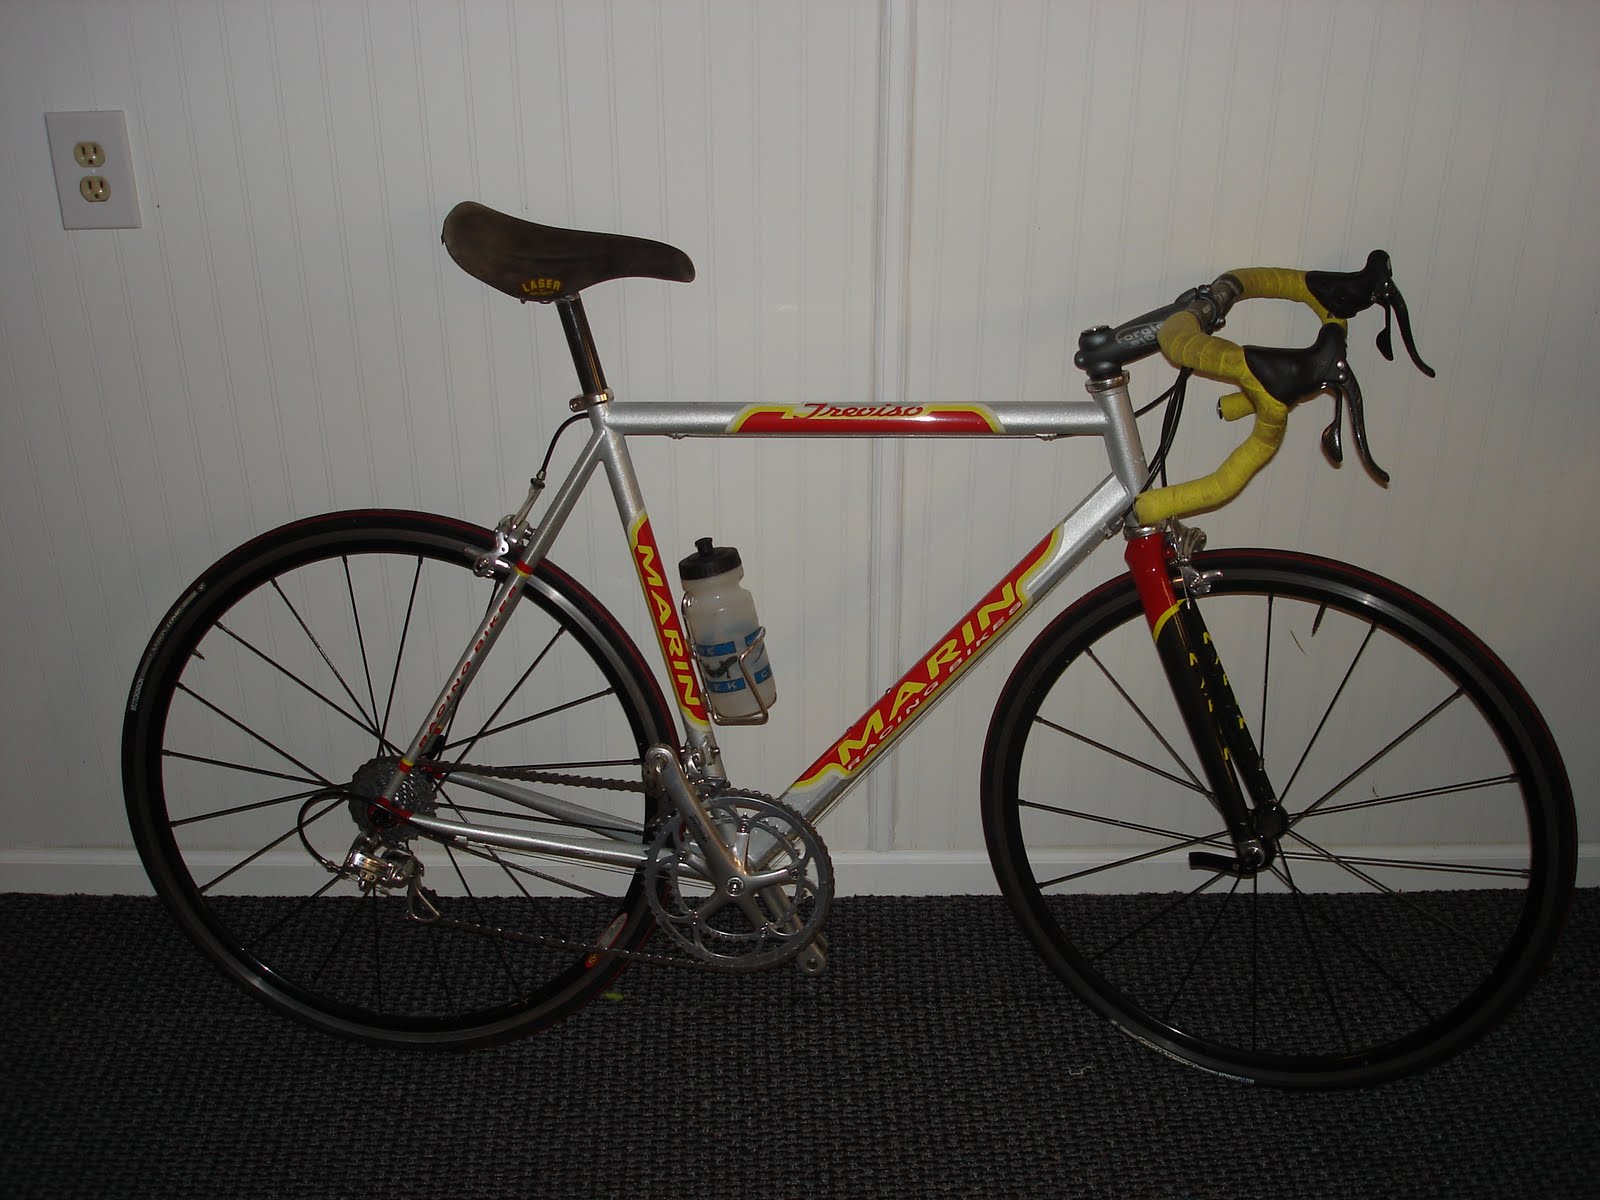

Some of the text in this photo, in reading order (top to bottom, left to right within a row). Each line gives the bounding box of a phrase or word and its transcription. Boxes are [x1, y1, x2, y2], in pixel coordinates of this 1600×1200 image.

[521, 278, 561, 293] LASER
[804, 403, 923, 418] Treviso
[636, 544, 702, 705] MARIN
[837, 581, 1016, 766] MARIN
[847, 601, 1023, 771] RACING BIKES
